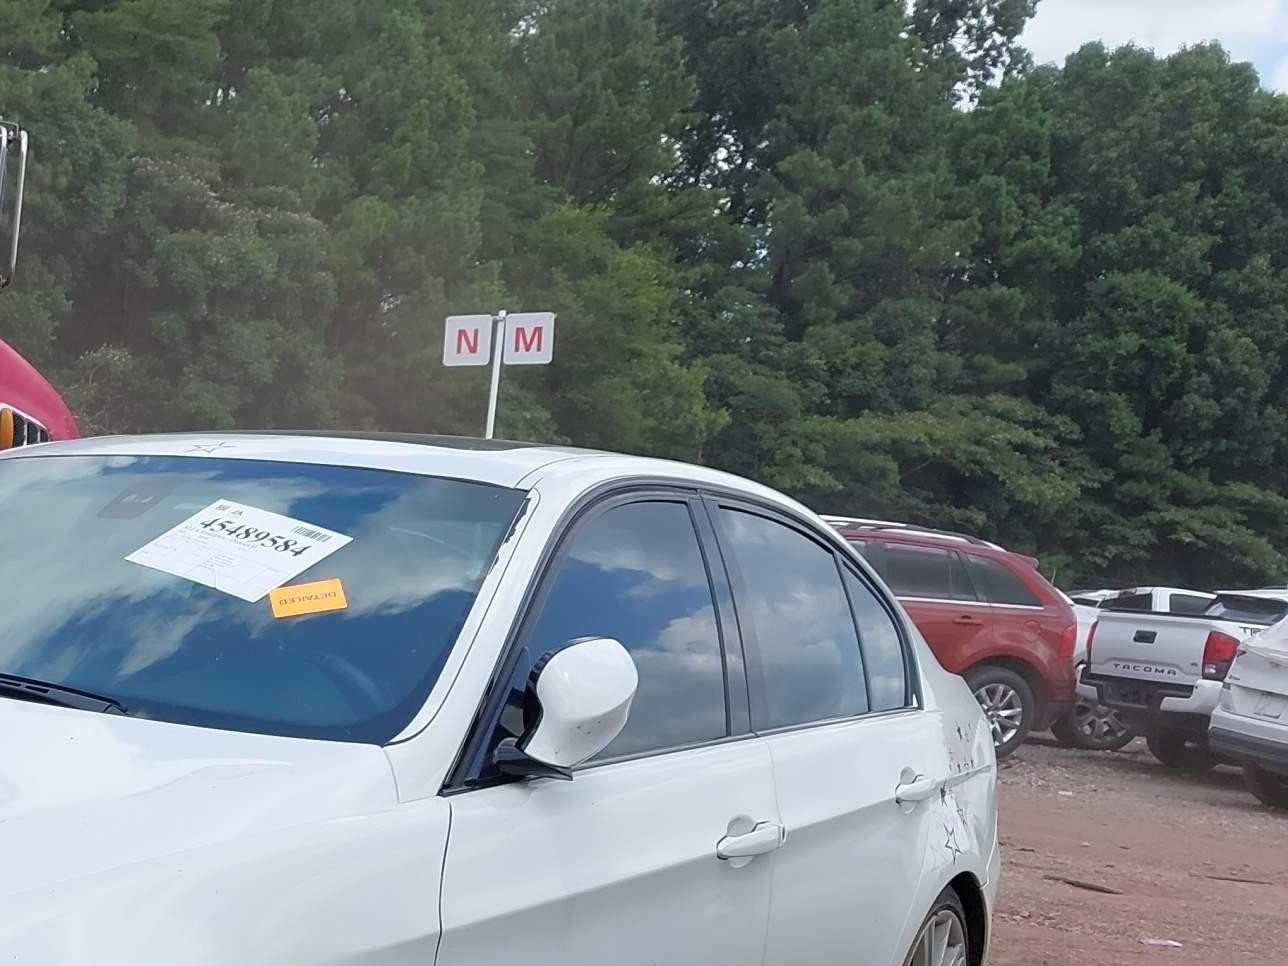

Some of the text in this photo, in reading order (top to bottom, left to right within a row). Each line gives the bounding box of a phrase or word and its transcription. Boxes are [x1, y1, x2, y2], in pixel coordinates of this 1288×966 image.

[456, 328, 479, 354] N
[514, 326, 543, 352] M
[199, 518, 312, 557] 45489584
[279, 591, 337, 606] DETAILED
[1113, 663, 1177, 676] TACOMA
